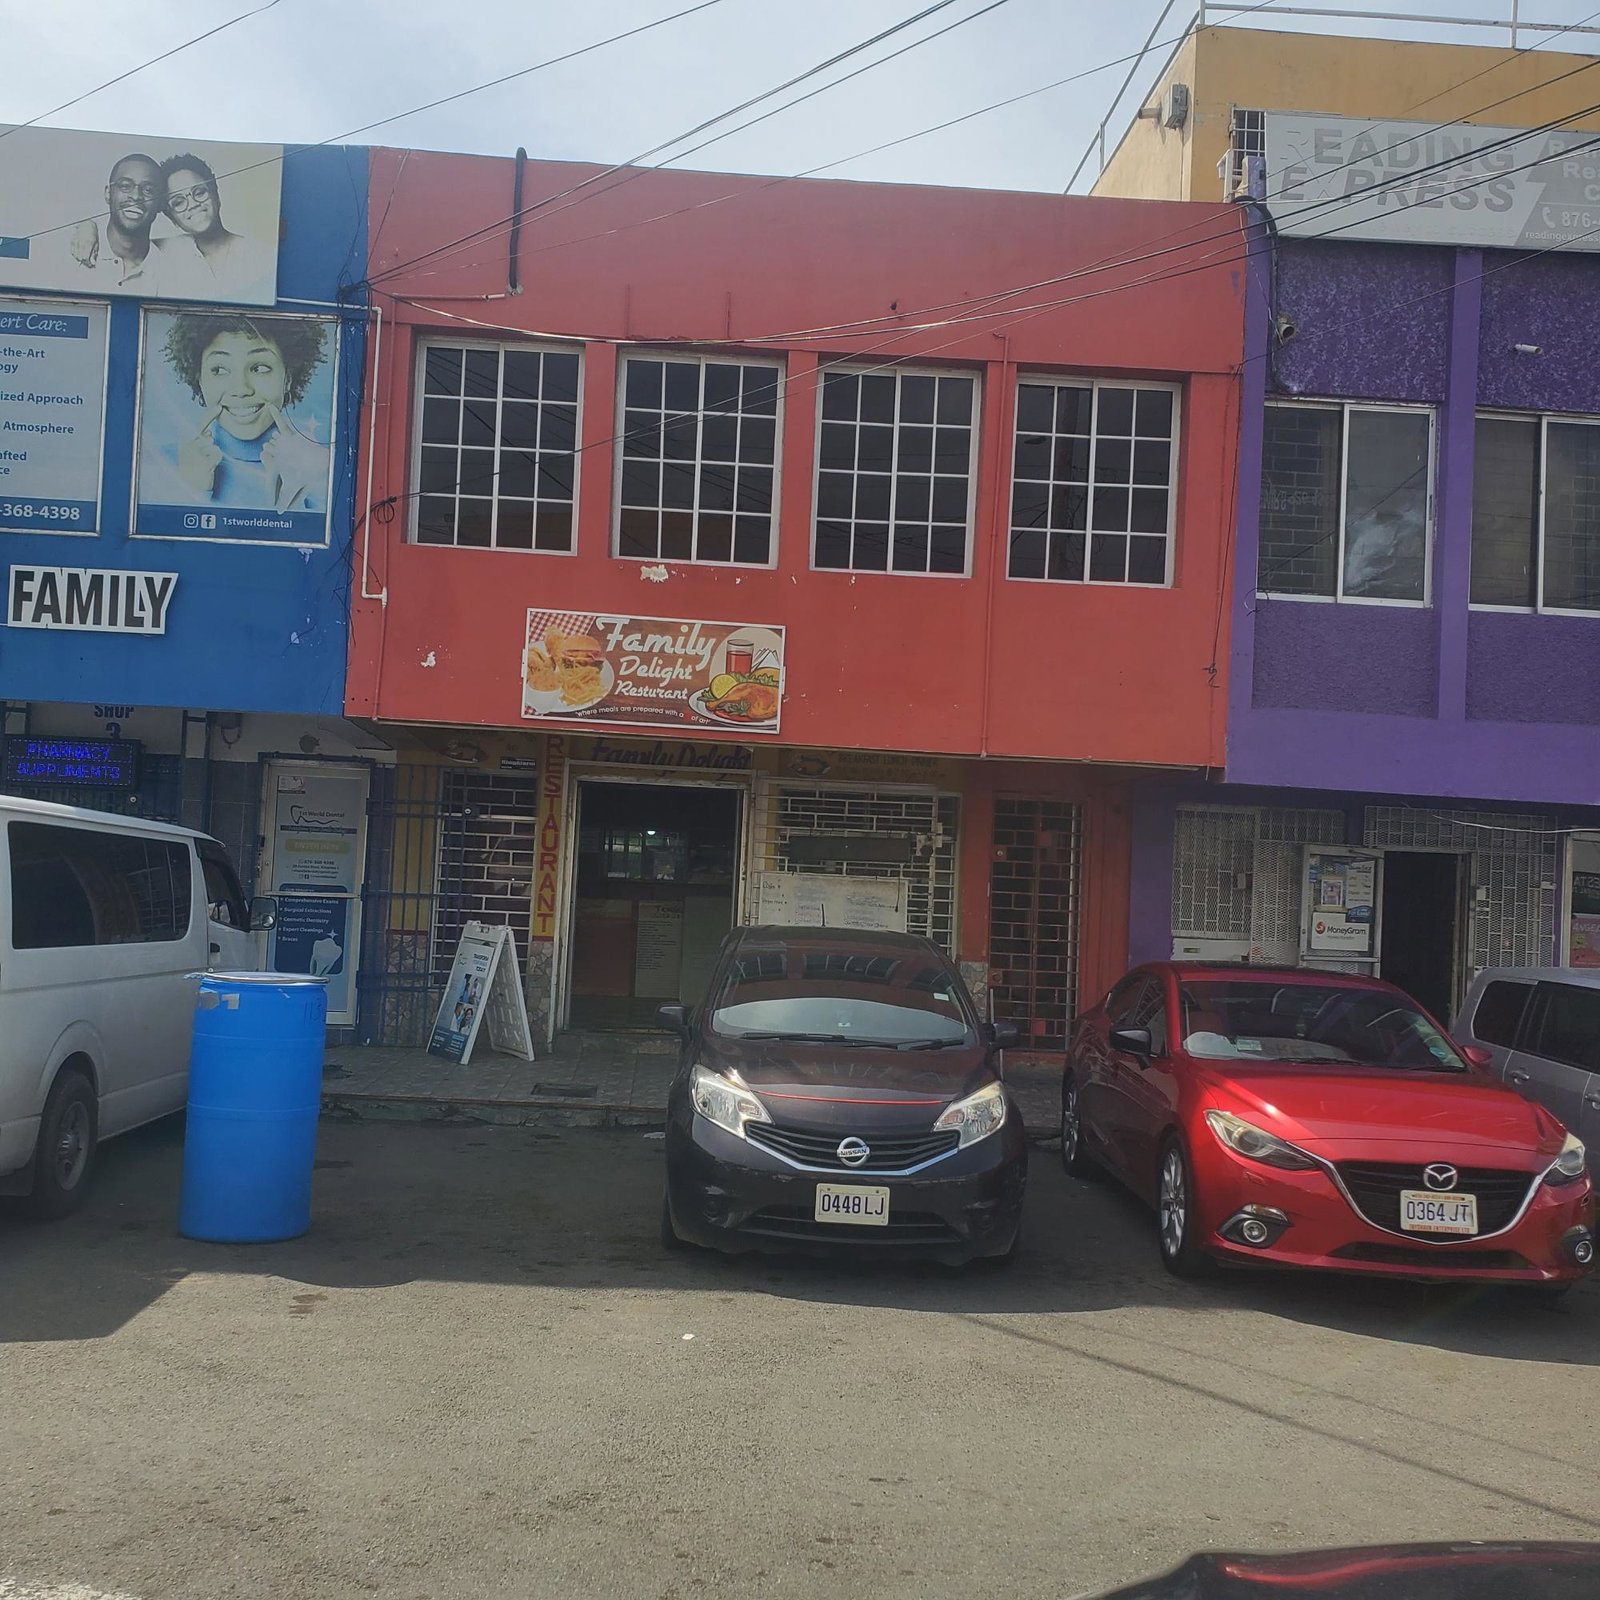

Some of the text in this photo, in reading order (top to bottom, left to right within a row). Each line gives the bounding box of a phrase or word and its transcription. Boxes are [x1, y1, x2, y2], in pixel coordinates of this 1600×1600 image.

[26, 314, 67, 332] Care:
[27, 392, 83, 405] Approach
[3, 421, 74, 434] Atmosphere
[222, 517, 293, 529] 1stworlddental
[12, 570, 172, 628] FAMILY
[595, 616, 717, 671] Family
[619, 655, 693, 687] Delight
[614, 680, 688, 700] Resturant
[599, 706, 619, 714] meals
[632, 706, 664, 715] prepared
[536, 734, 565, 933] RESTAURANT
[1327, 926, 1366, 935] MoneyGram
[1407, 1201, 1469, 1222] 0364 JT
